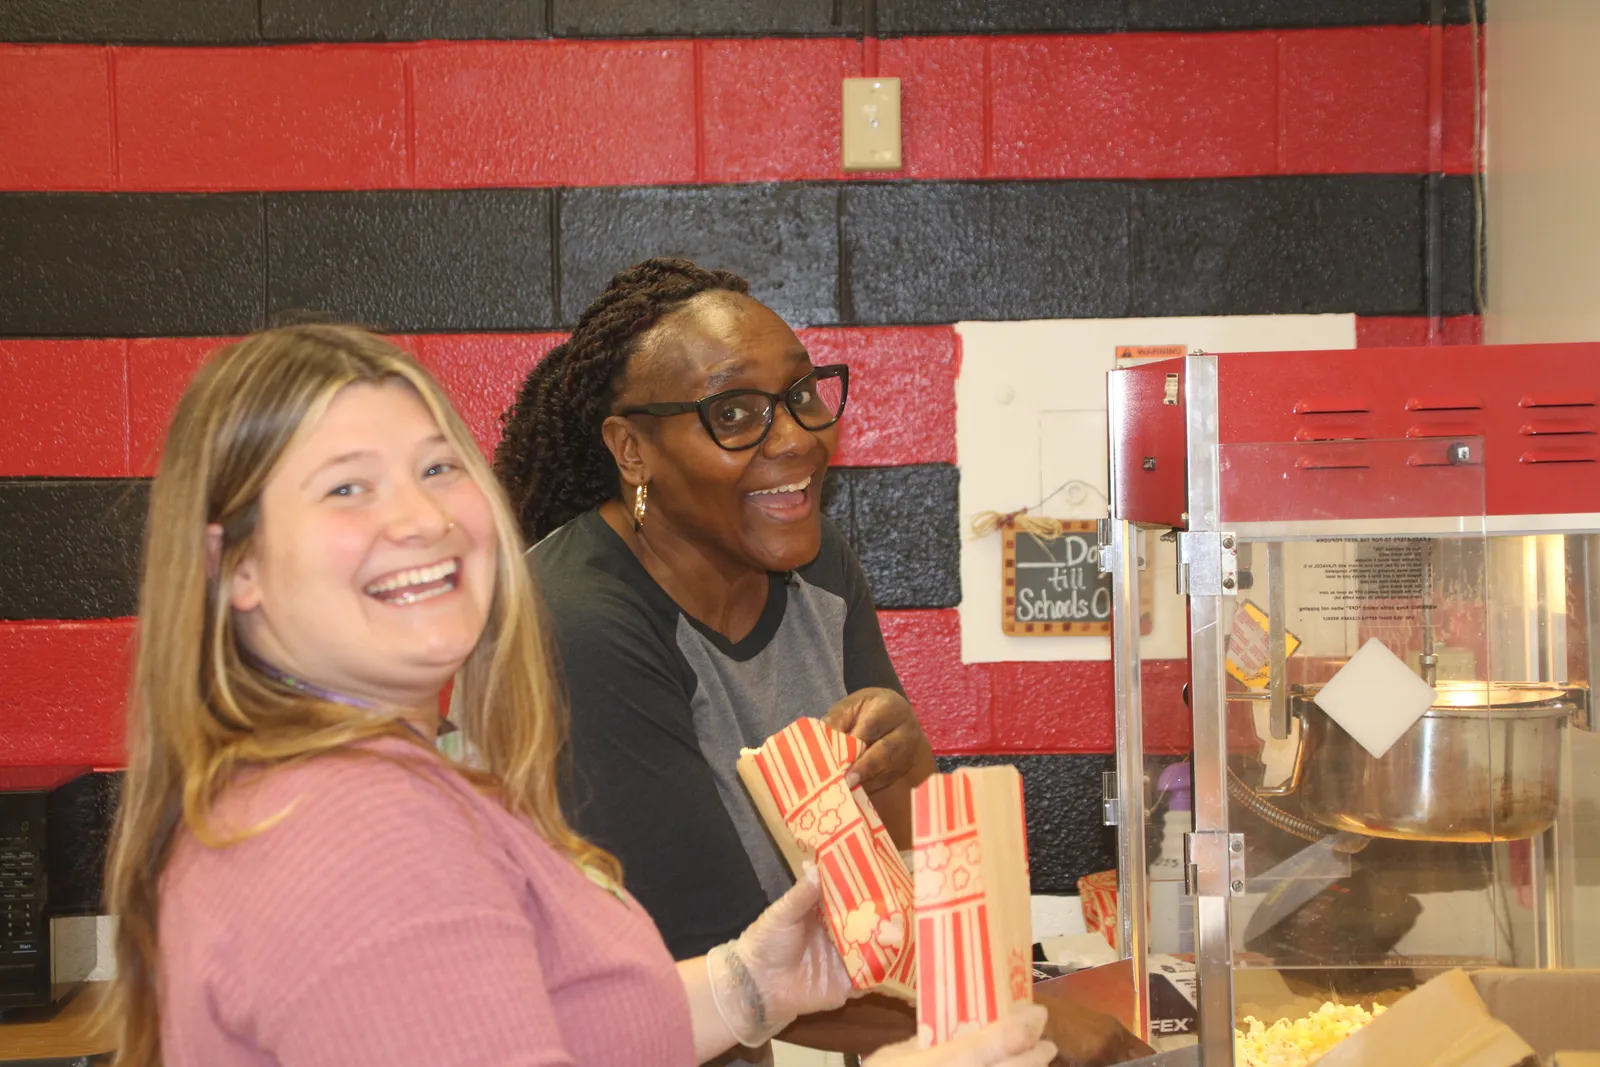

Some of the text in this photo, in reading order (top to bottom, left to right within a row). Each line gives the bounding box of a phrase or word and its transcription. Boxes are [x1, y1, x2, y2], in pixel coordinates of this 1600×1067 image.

[1137, 347, 1182, 355] WARNING
[1064, 535, 1099, 567] Da
[1047, 567, 1086, 592] till
[1017, 586, 1110, 620] Schools O
[1149, 1018, 1189, 1032] FEX
